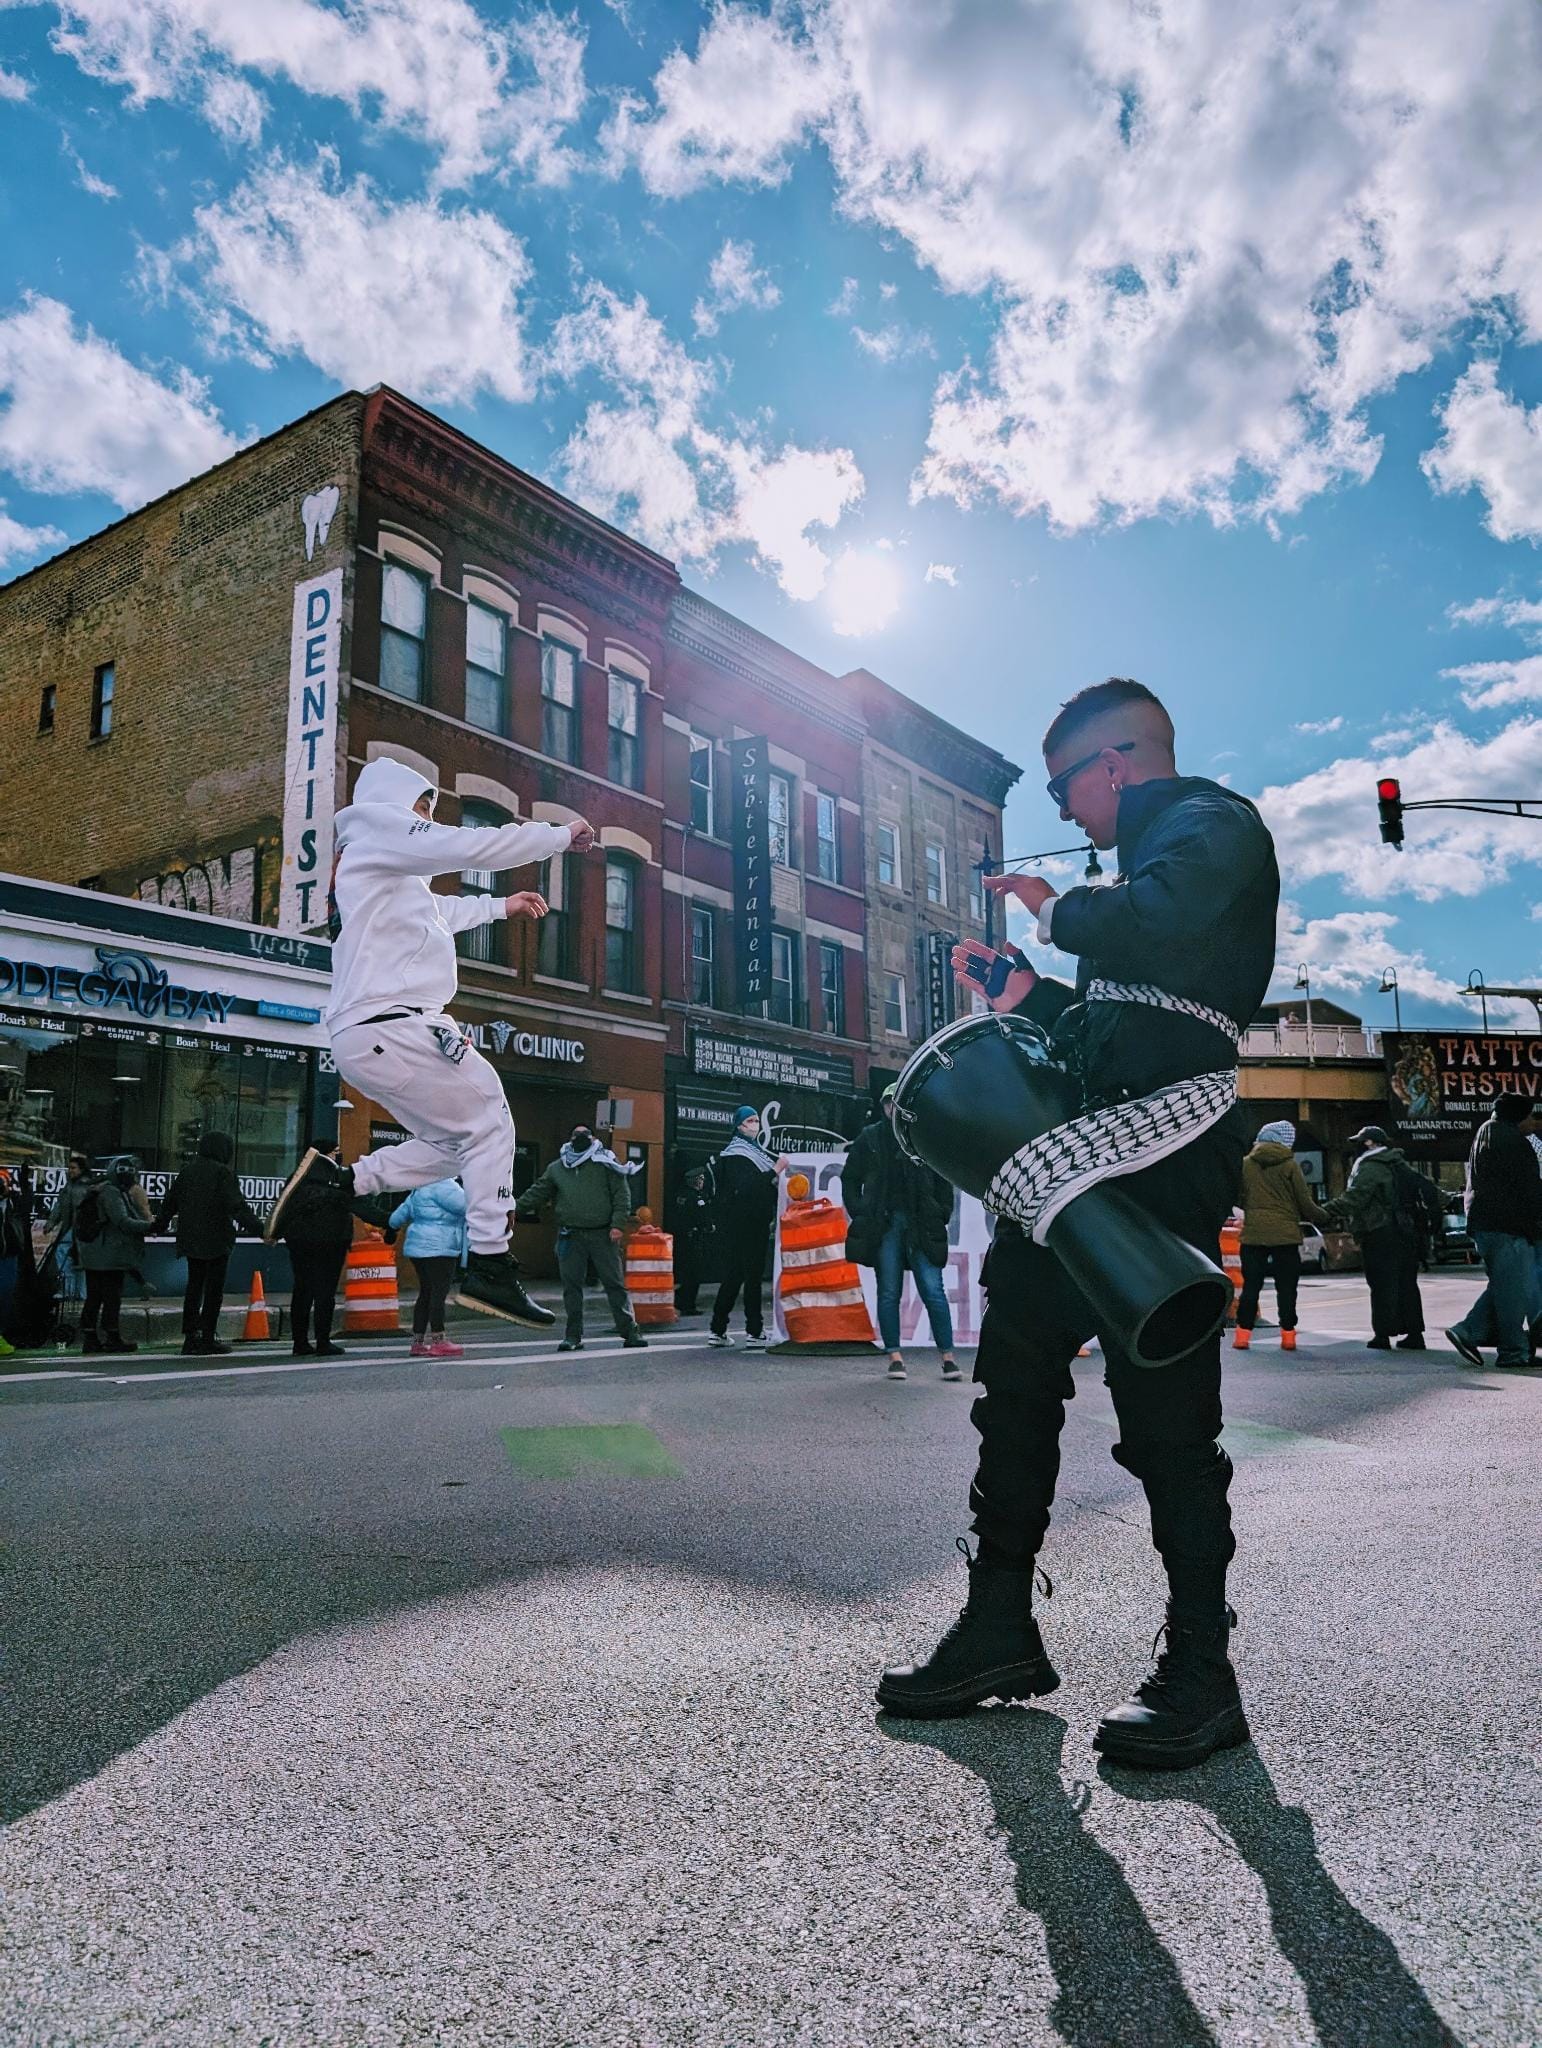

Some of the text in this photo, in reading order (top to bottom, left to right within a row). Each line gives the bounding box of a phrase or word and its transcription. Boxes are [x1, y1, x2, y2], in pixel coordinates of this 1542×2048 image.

[296, 588, 331, 924] DENTIST
[742, 747, 761, 993] Subterranean
[165, 985, 237, 1024] BAY
[41, 1018, 65, 1032] Head
[97, 1025, 145, 1037] DARK MATTER
[108, 1032, 135, 1041] COFFEE
[210, 1040, 231, 1053] Head
[273, 1047, 296, 1057] MATTER
[517, 1032, 585, 1063] CLINIC
[265, 1052, 288, 1060] COFFEE
[1441, 1071, 1542, 1097] FESTIV
